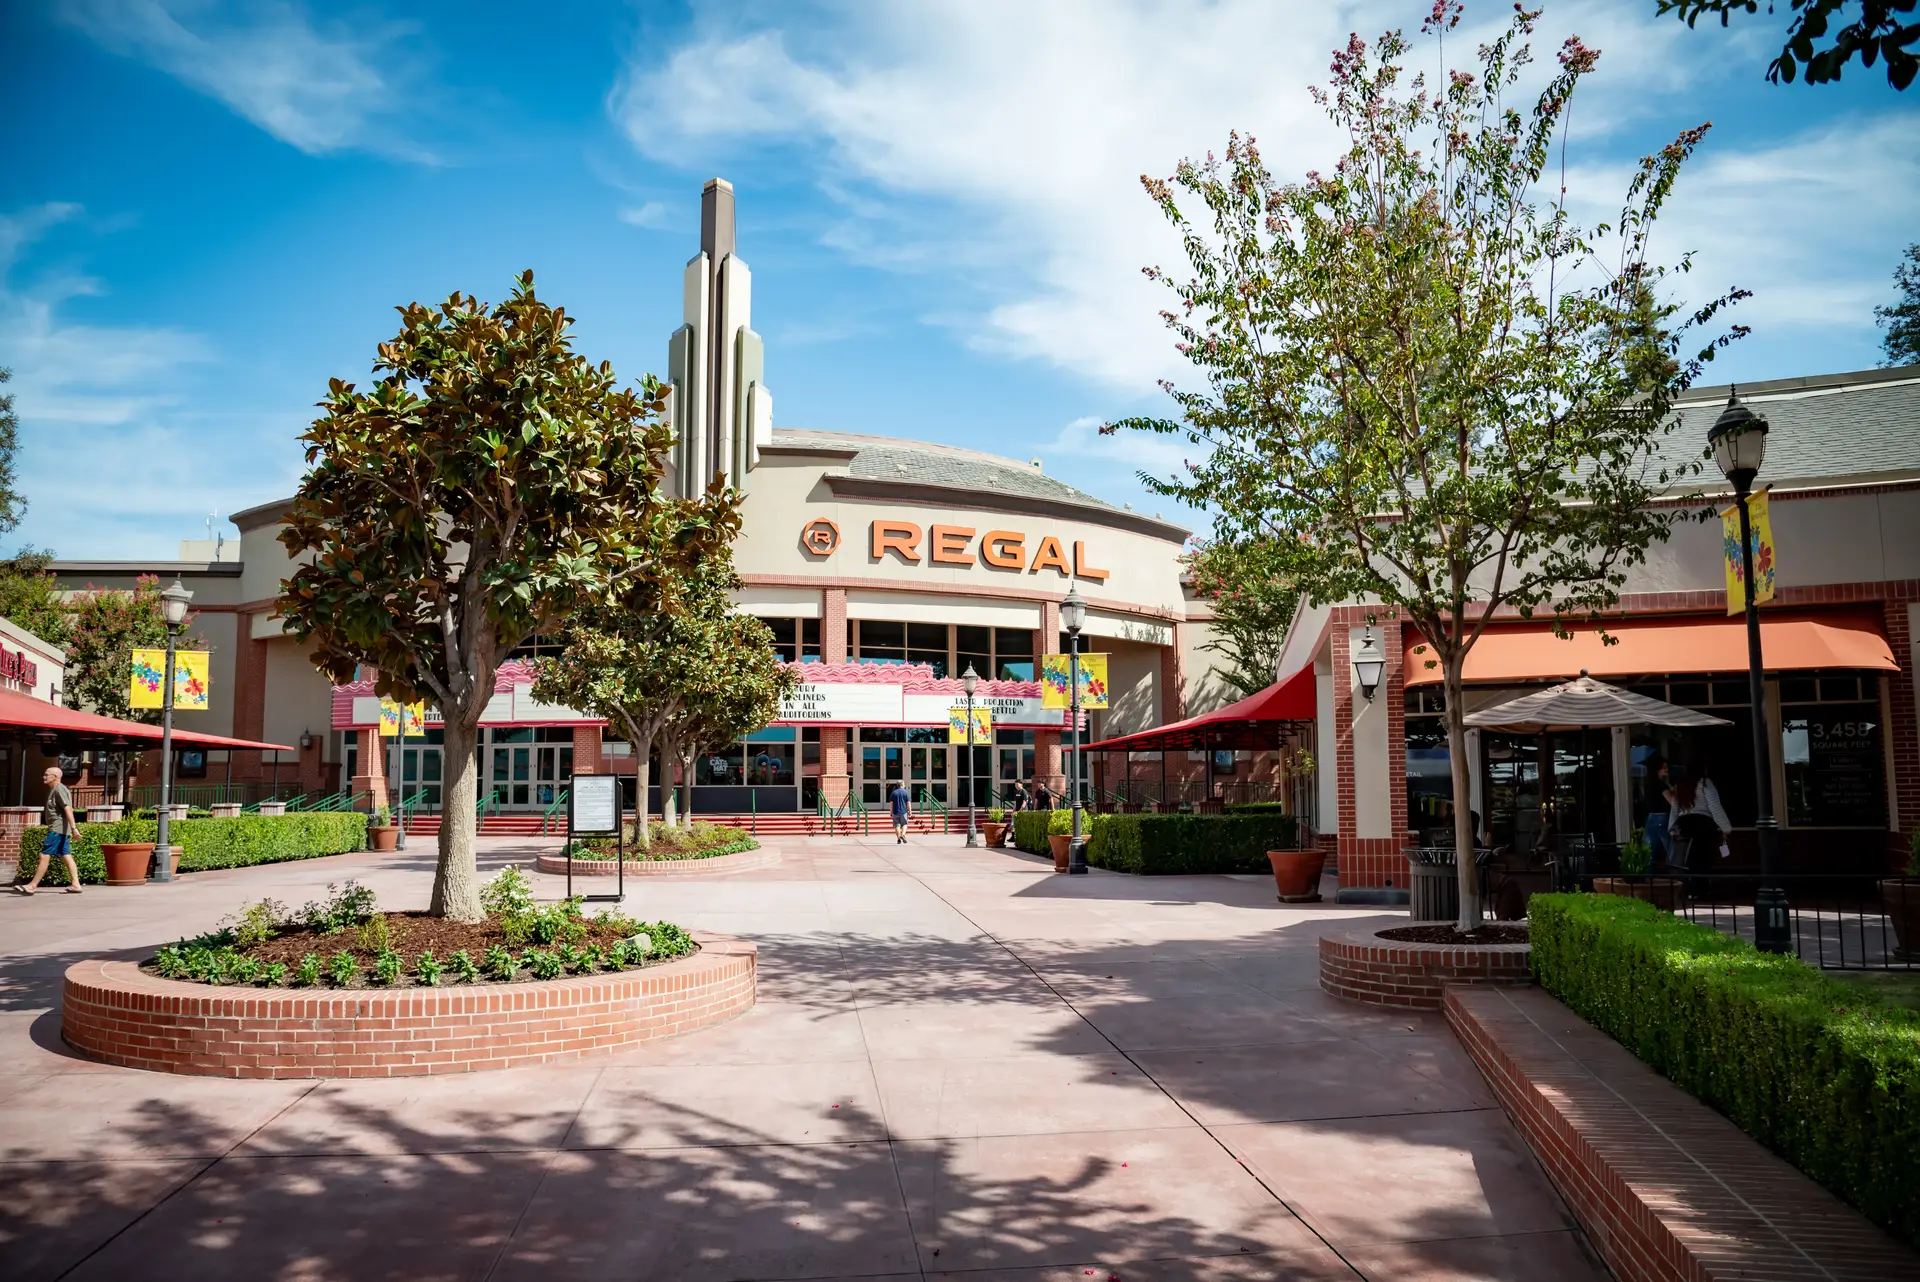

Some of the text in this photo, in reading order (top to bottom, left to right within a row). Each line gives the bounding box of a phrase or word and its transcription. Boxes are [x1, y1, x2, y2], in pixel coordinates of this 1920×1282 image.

[871, 519, 1110, 579] REGAL
[785, 702, 816, 710] IN ALL
[955, 697, 976, 705] LASR
[983, 699, 1024, 707] PROJECTION
[992, 706, 1017, 715] BETTER
[779, 711, 832, 719] AUDITORIUMS
[1812, 721, 1870, 740] 3,458
[1812, 741, 1850, 749] SQUARE
[709, 758, 724, 766] CAT
